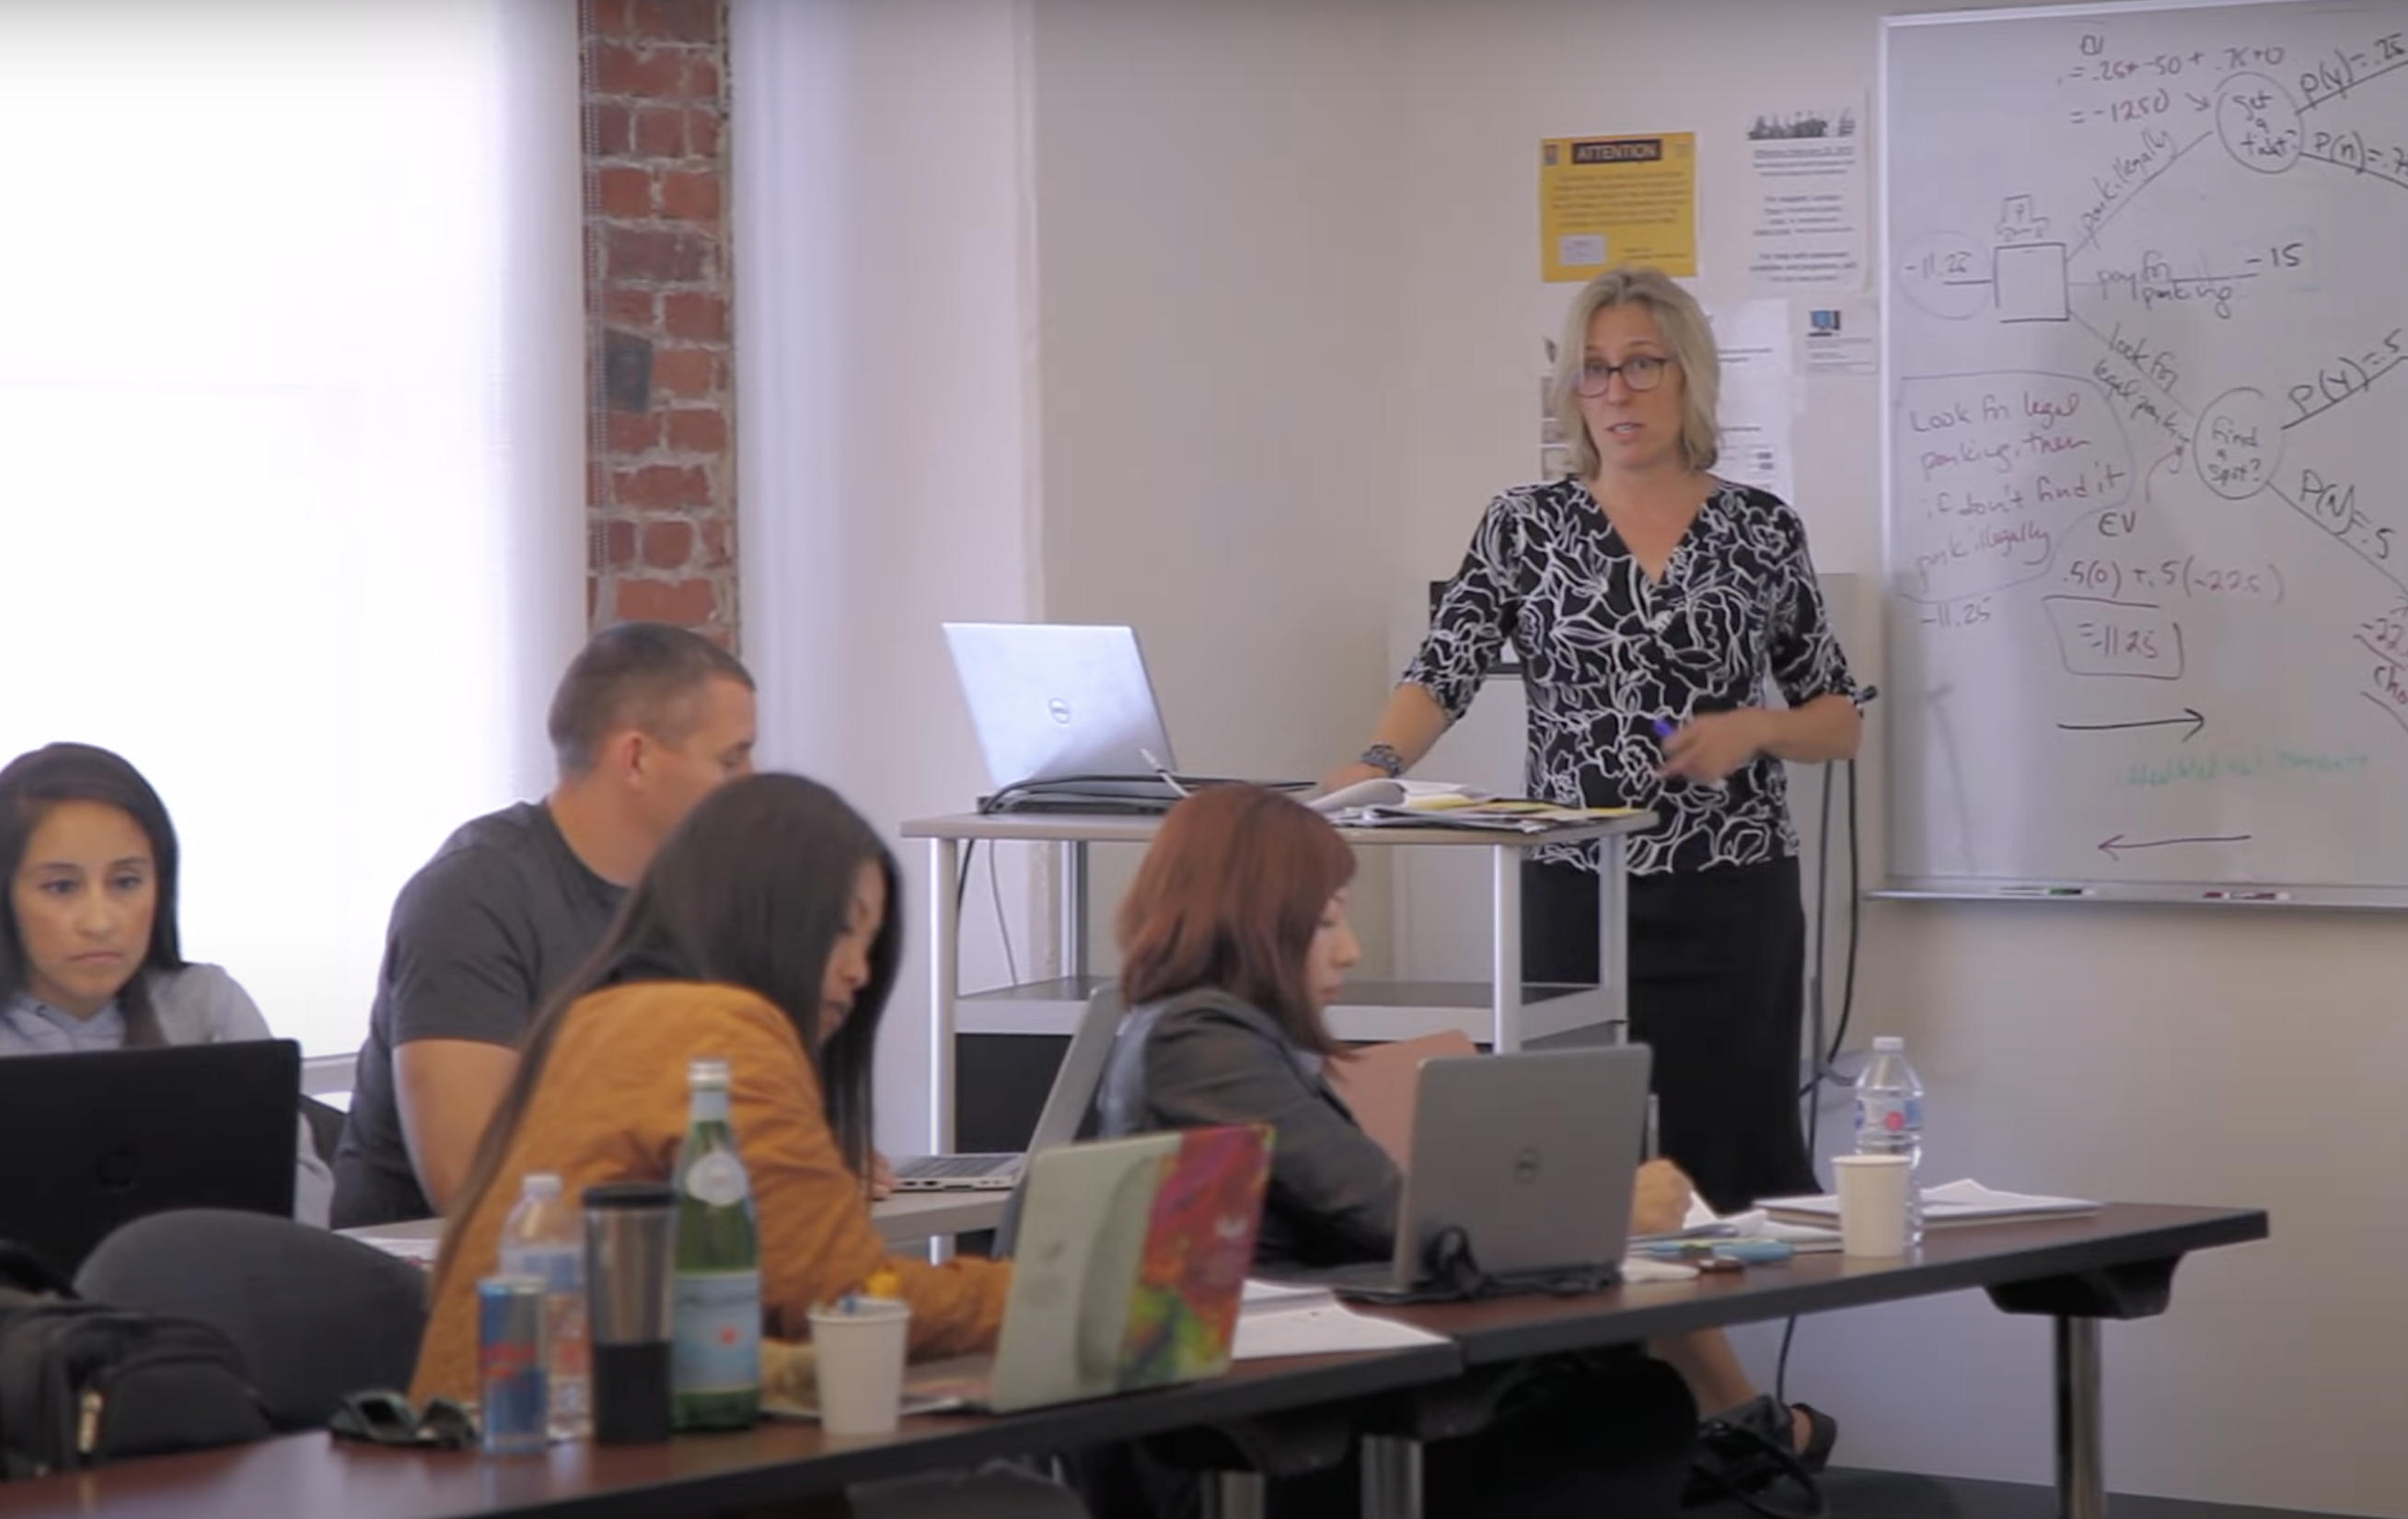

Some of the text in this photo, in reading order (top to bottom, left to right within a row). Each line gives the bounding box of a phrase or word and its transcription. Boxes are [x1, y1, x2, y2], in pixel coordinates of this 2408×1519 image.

[1576, 145, 1657, 162] ATTENTION
[1910, 402, 1972, 433] Look
[2024, 391, 2080, 430] legal
